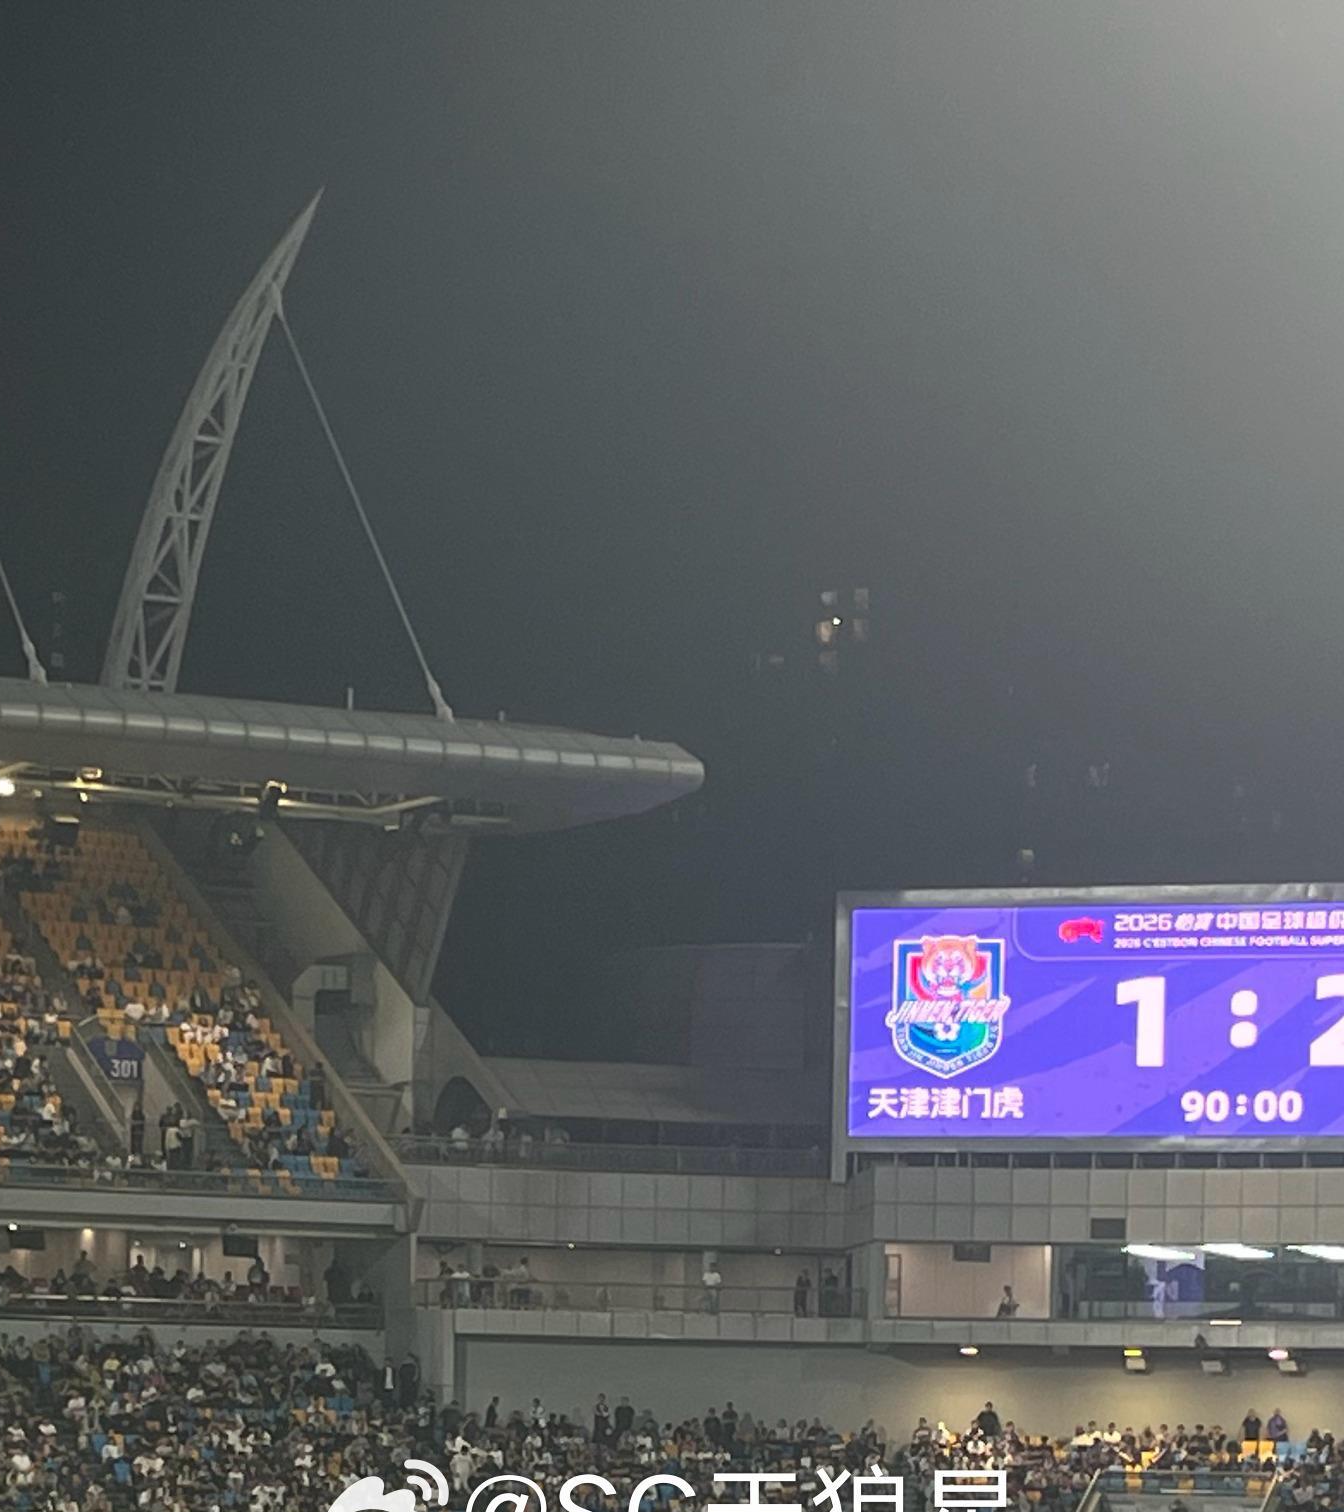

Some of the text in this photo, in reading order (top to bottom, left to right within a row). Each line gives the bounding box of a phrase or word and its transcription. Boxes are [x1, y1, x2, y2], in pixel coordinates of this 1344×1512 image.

[1249, 935, 1308, 947] FOOTBALL
[1115, 976, 1167, 1068] 1
[110, 1059, 139, 1079] 301
[867, 1086, 1025, 1119] 天津津门虎
[1180, 1090, 1304, 1123] 90:00
